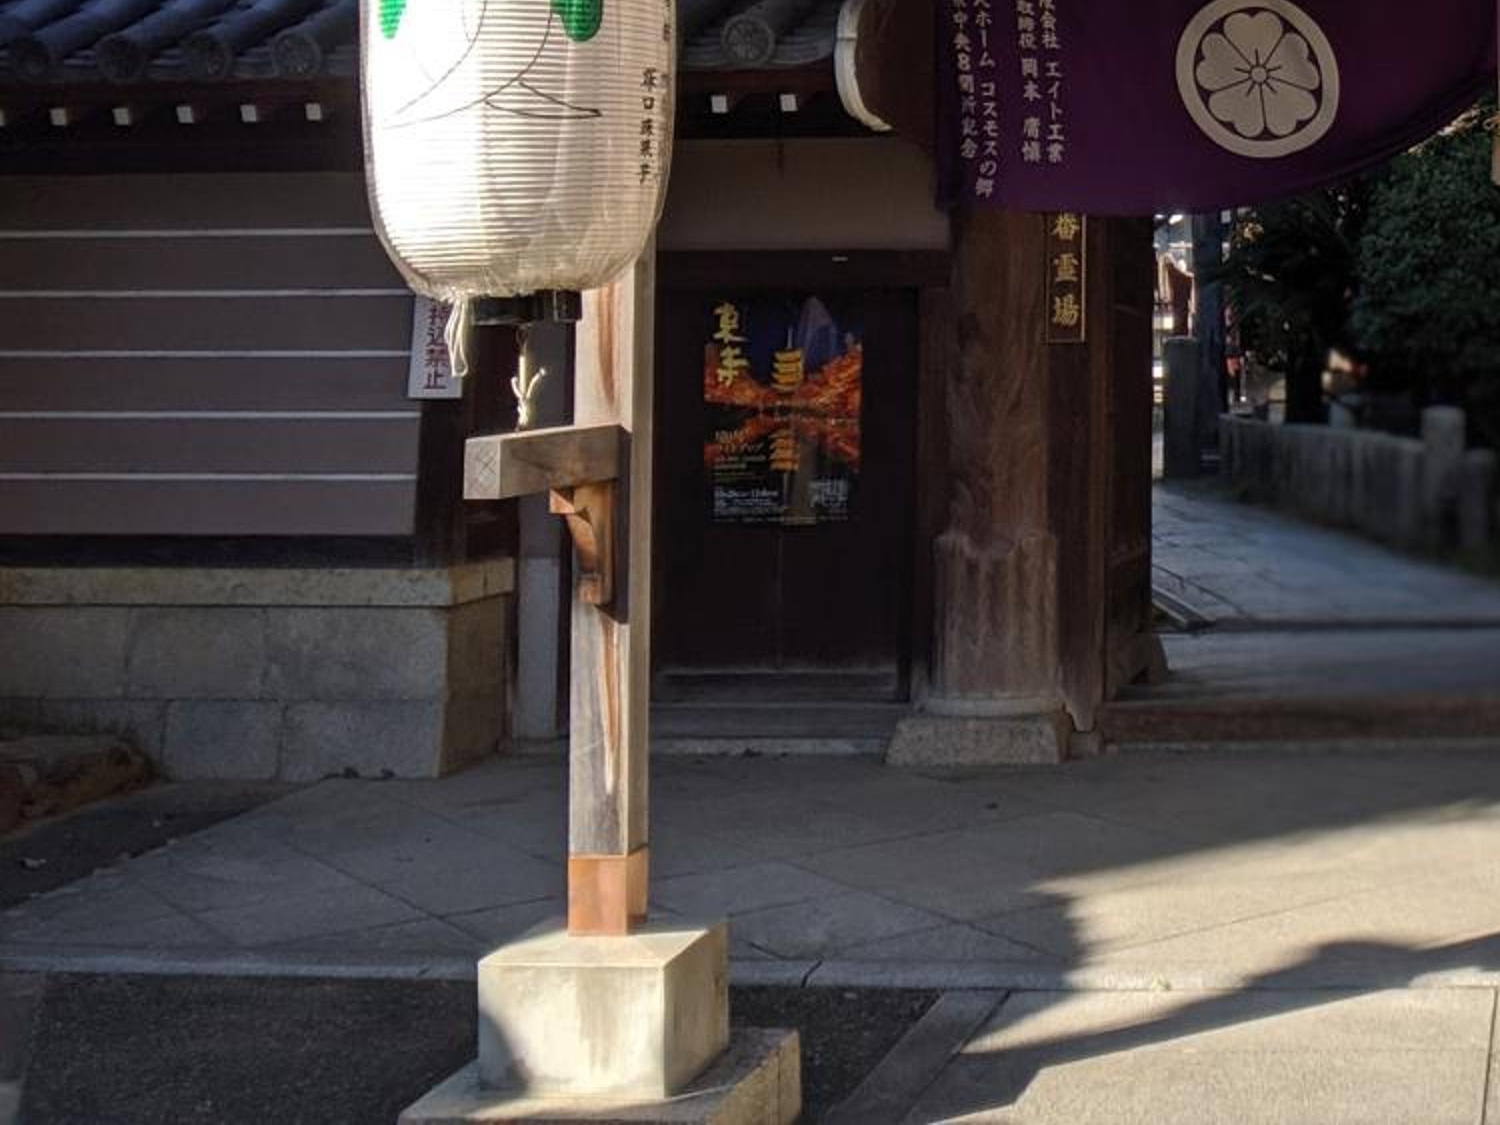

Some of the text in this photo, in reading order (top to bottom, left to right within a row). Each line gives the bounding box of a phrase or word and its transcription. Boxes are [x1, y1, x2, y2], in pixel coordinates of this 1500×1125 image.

[1045, 62, 1065, 163] エイト工業
